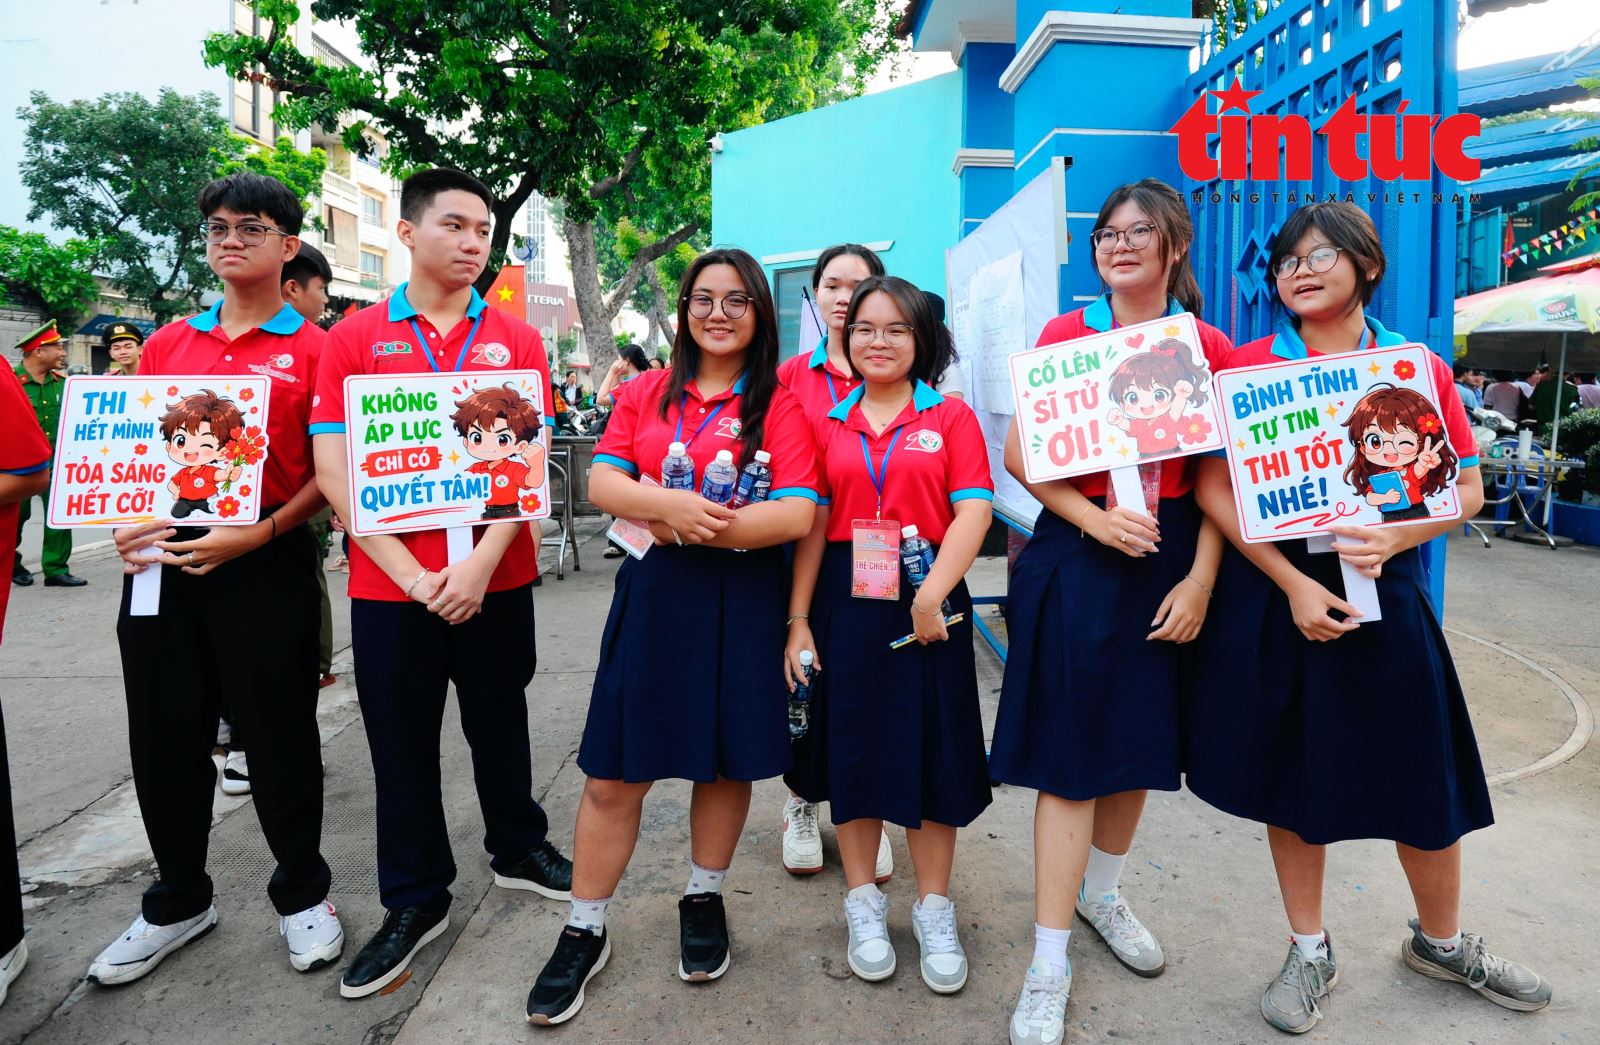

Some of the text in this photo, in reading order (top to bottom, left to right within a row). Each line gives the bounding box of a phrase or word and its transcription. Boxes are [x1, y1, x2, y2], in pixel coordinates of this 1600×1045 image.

[1029, 350, 1101, 387] CỐ LÊN
[82, 391, 127, 415] THI
[362, 387, 438, 415] KHÔNG
[1034, 379, 1099, 424] SĨ TỬ
[1232, 366, 1359, 420] BÌNH TĨNH
[74, 417, 154, 441] HẾT MÌNH
[365, 419, 442, 444] ÁP LỰC
[1248, 407, 1320, 445] TỰ TIN
[1048, 419, 1102, 467] ƠI!
[1243, 430, 1344, 484] THI TỐT
[65, 456, 166, 484] TỎA SÁNG
[375, 449, 430, 472] CHỈ CÓ
[66, 486, 154, 516] HẾT CỠ!
[361, 473, 489, 512] QUYẾT TÂM!
